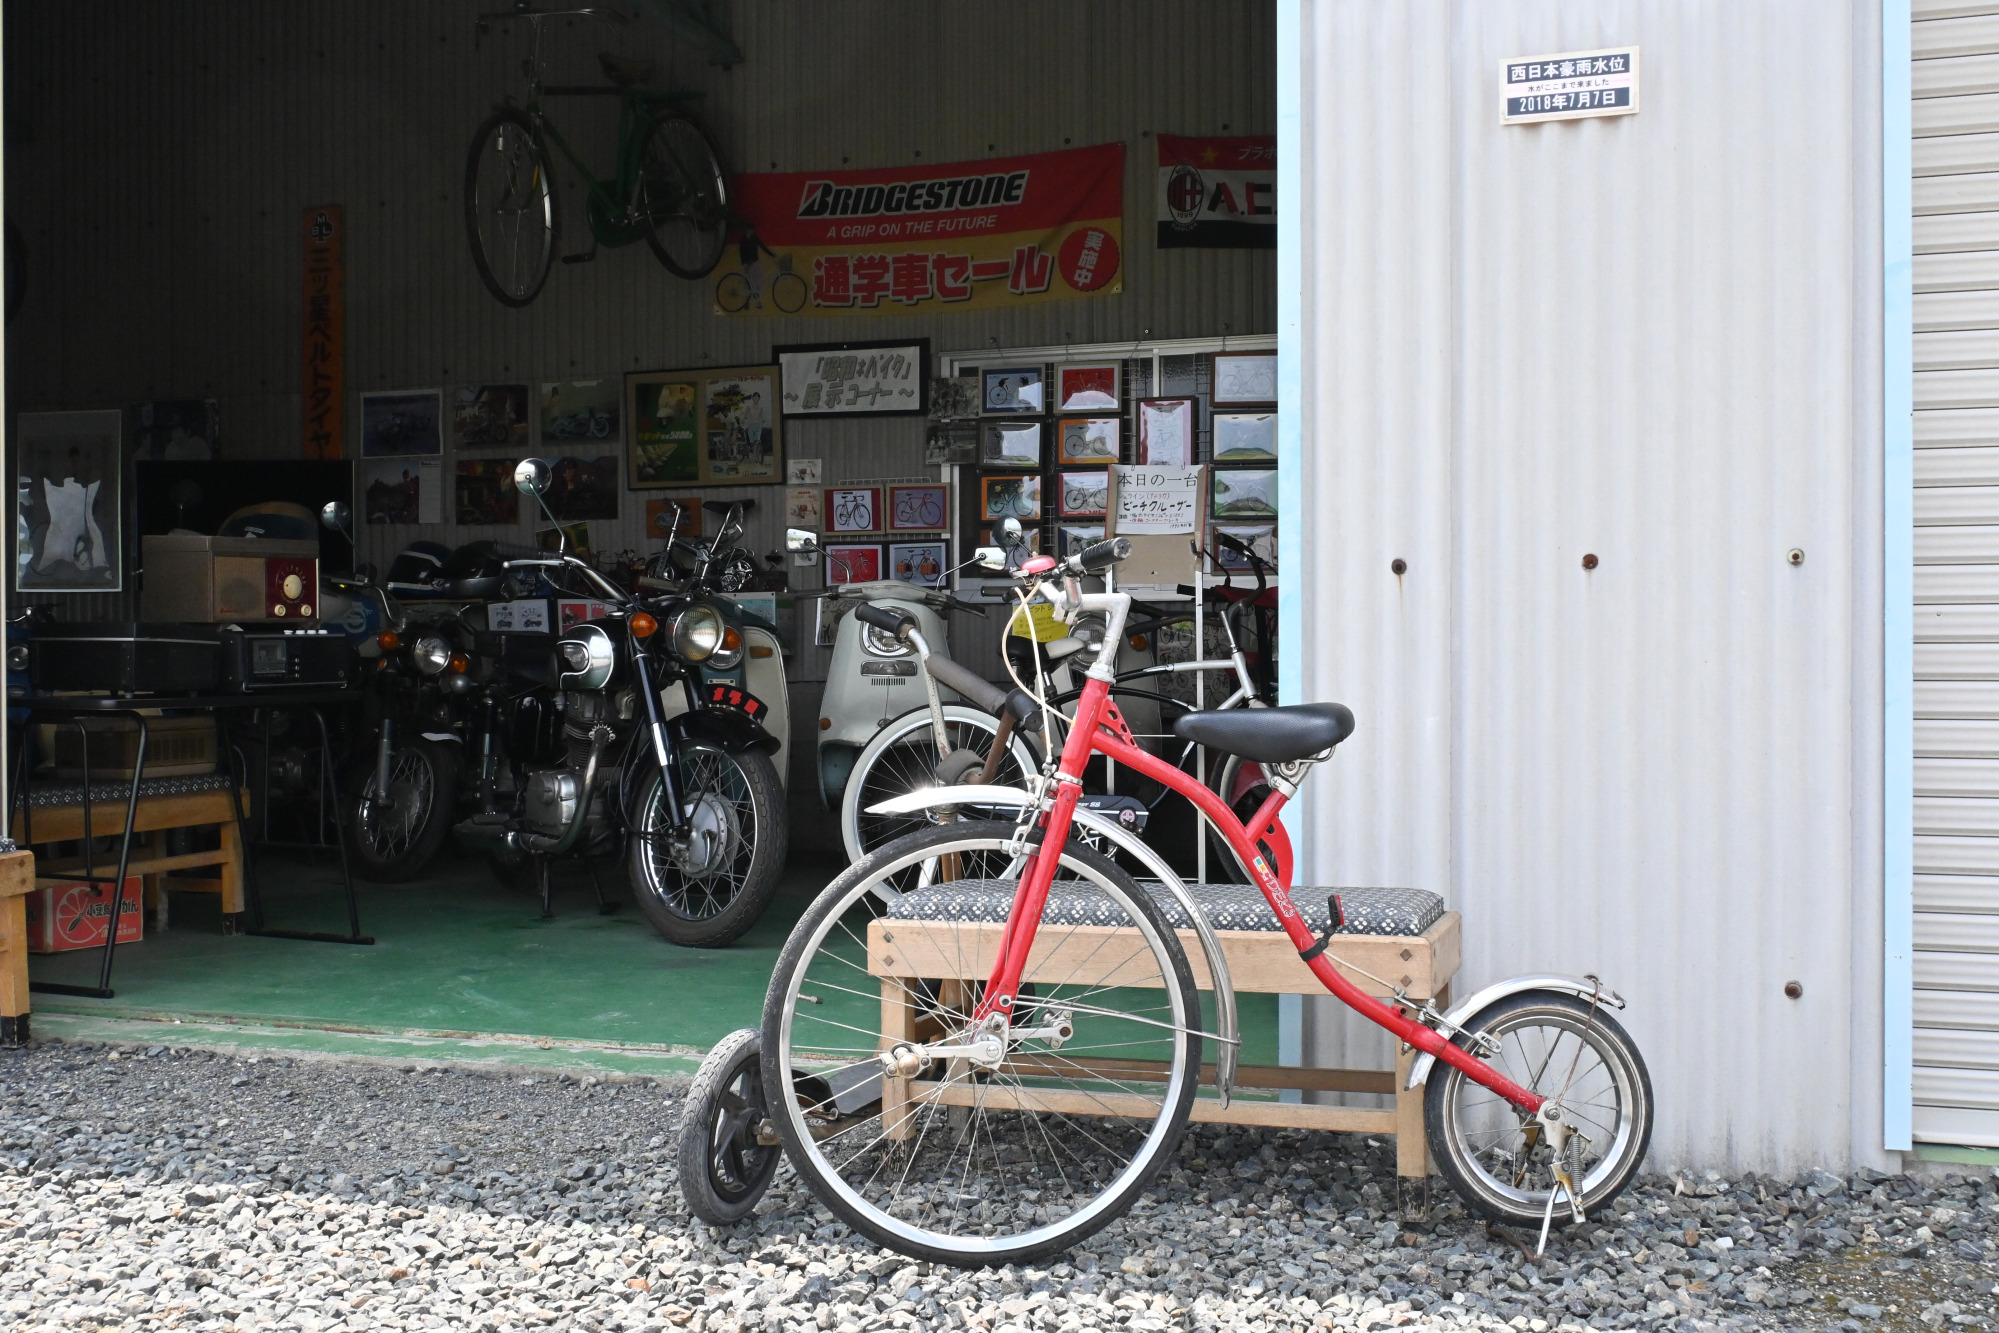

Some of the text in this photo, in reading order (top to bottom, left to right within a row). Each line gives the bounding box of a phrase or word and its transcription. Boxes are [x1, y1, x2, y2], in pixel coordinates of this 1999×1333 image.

[1511, 56, 1625, 81] 西日本豪雨水位
[1527, 78, 1610, 93] 水がここまで来ました
[1519, 90, 1616, 112] 2018年7月7日
[798, 172, 1028, 218] BRIDGESTONE
[826, 215, 998, 239] A GRIP ON THE FUTURE
[1073, 230, 1104, 287] 実施中
[812, 244, 1053, 307] 通学車セール
[1117, 472, 1198, 487] 本日の一台
[1123, 500, 1192, 512] ビーチクルーザー
[87, 900, 139, 917] 小豆島かん
